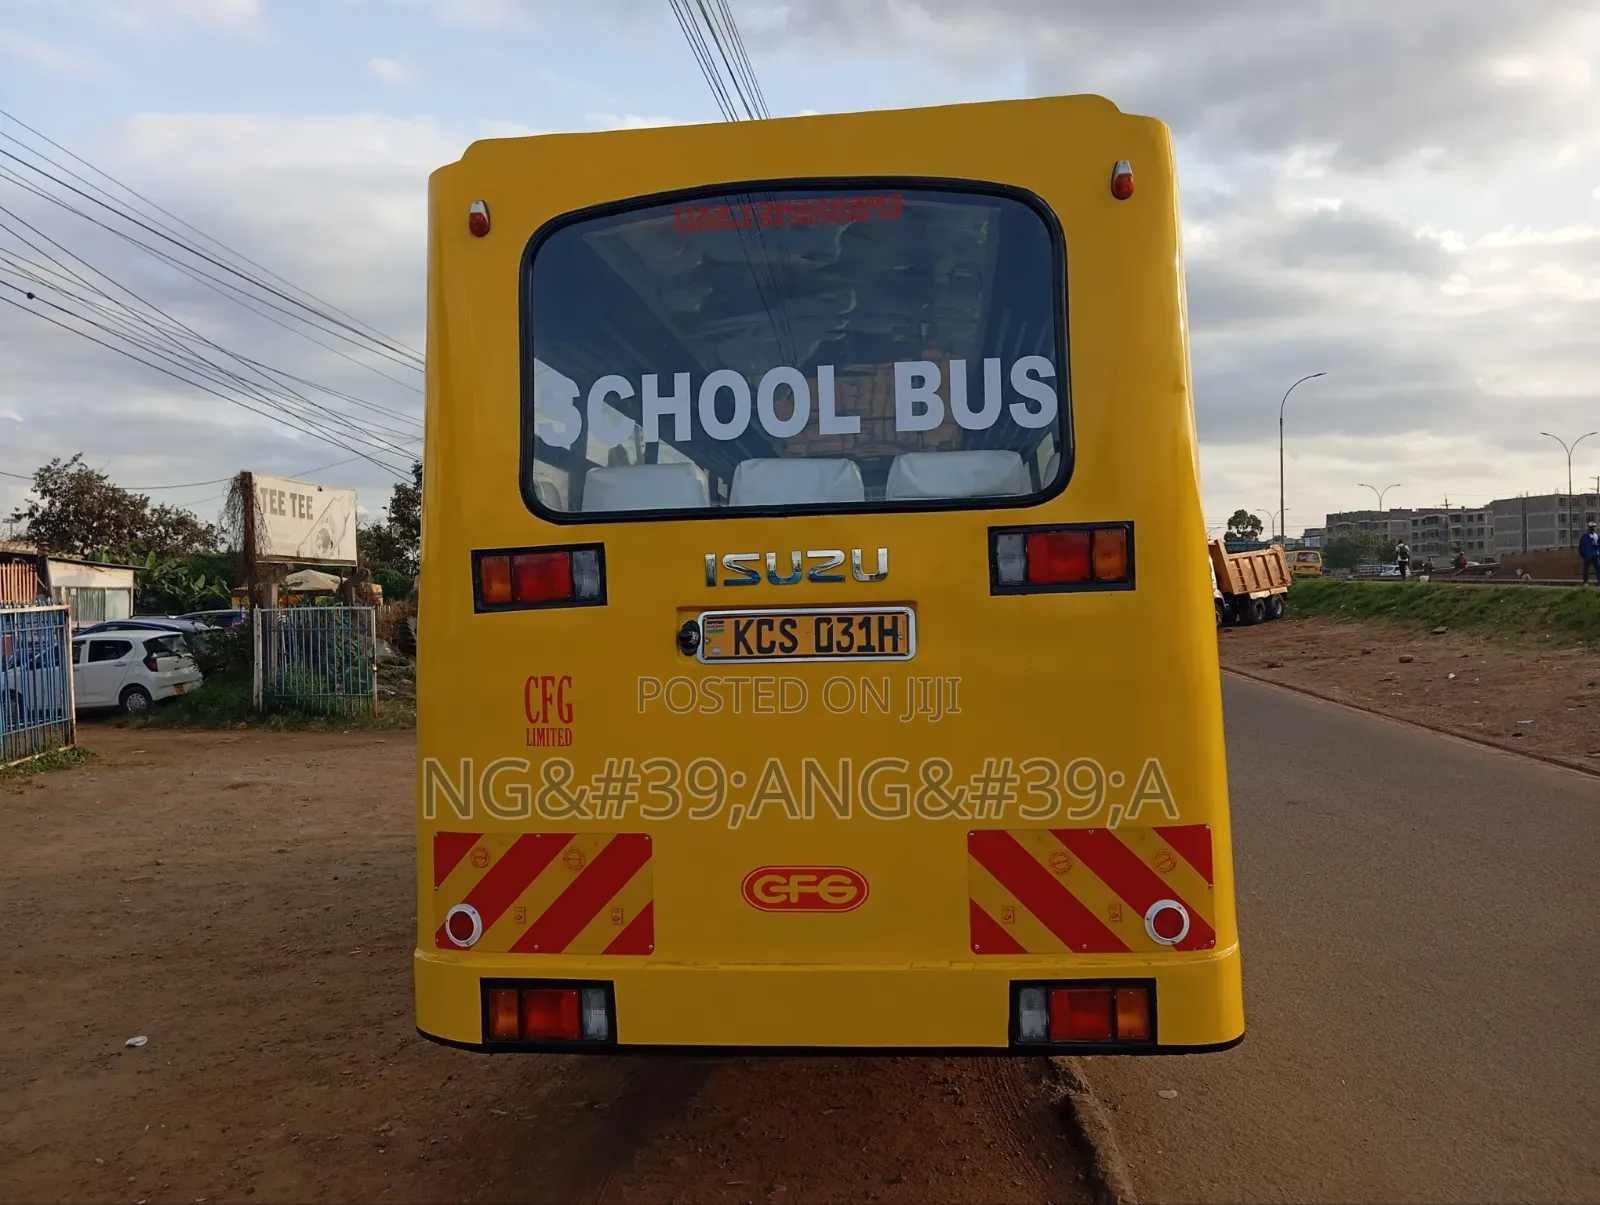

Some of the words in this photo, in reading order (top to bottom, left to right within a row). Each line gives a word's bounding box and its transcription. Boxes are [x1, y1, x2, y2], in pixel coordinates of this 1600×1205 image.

[535, 364, 861, 448] SCHOOL
[893, 355, 1058, 431] BUS
[259, 488, 286, 516] TEE
[290, 492, 314, 520] TEE
[704, 547, 889, 587] ISUZU
[734, 618, 799, 655] KCS
[814, 615, 899, 653] 031H
[524, 675, 573, 724] CFG
[525, 727, 573, 747] LIMITED
